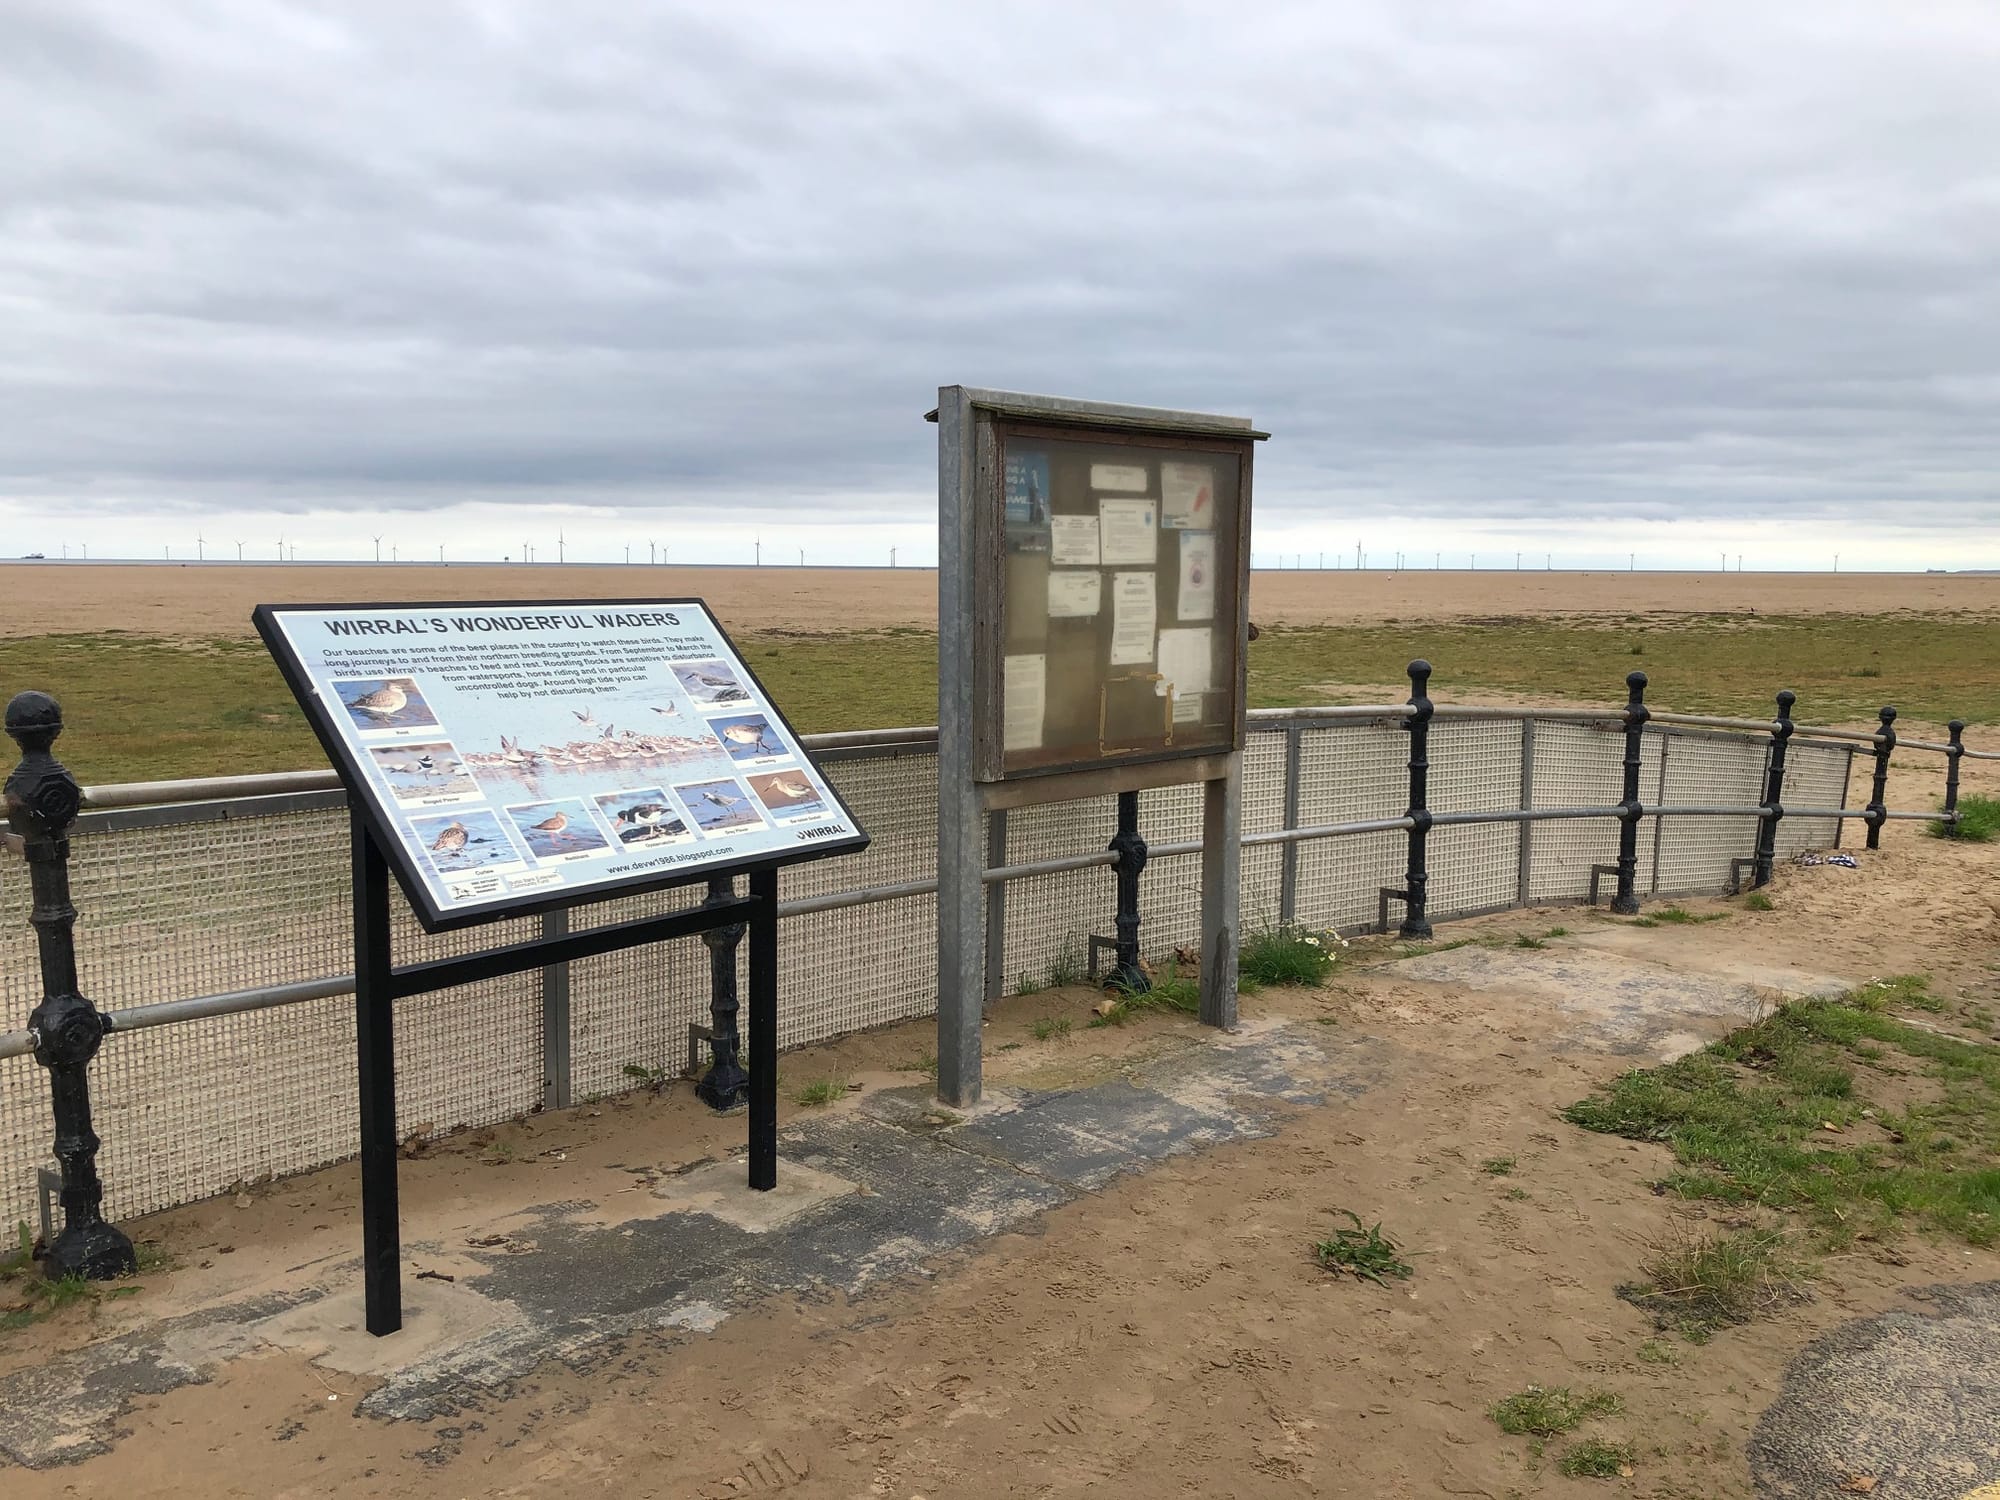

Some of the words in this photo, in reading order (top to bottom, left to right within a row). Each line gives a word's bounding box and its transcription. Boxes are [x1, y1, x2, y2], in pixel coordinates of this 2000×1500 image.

[323, 618, 448, 635] WIRRAL'S
[449, 615, 593, 632] WONDERFUL
[592, 612, 680, 627] WADERS
[322, 648, 342, 657] Our
[344, 646, 389, 656] beaches
[390, 647, 407, 655] are
[408, 646, 436, 654] some
[438, 644, 448, 653] of
[449, 644, 465, 653] the
[465, 643, 488, 652] best
[489, 642, 519, 652] places
[519, 641, 530, 650] in
[530, 641, 546, 649] the
[547, 640, 579, 649] country
[580, 639, 590, 647] to
[591, 638, 616, 647] watch
[616, 638, 640, 646] these
[639, 636, 664, 645] birds.
[663, 635, 683, 644] They
[683, 634, 704, 643] make
[324, 658, 350, 668] long
[350, 657, 396, 667] journeys
[397, 656, 409, 664] to
[410, 654, 430, 664] and
[430, 654, 455, 663] from
[455, 652, 477, 662] their
[479, 651, 519, 661] northern
[519, 650, 561, 659] breeding
[561, 648, 597, 658] grounds.
[599, 647, 622, 655] From
[622, 645, 665, 655] September
[665, 644, 675, 652] to
[674, 643, 700, 651] March
[699, 642, 712, 650] the
[333, 667, 362, 677] birds
[364, 668, 383, 676] use
[384, 665, 424, 675] Wirral's
[425, 663, 467, 673] beaches
[468, 663, 479, 671] to
[479, 661, 501, 671] feed
[502, 660, 520, 670] and
[521, 660, 542, 668] rest.
[542, 658, 583, 667] Roosting
[583, 656, 609, 665] flocks
[625, 654, 661, 663] sensitive
[671, 651, 715, 661] disturbance
[441, 673, 466, 682] from
[466, 671, 525, 681] watersports,
[525, 669, 552, 678] horse
[553, 668, 580, 677] riding
[580, 666, 597, 675] and
[597, 666, 607, 674] in
[607, 663, 646, 673] particular
[454, 680, 514, 691] uncontrolled
[515, 679, 542, 689] dogs.
[543, 677, 576, 686] Around
[575, 675, 596, 685] high
[596, 675, 614, 683] tide
[614, 674, 631, 684] you
[632, 673, 647, 681] can
[496, 690, 518, 700] help
[518, 689, 531, 699] by
[532, 688, 549, 697] not
[550, 685, 595, 695] disturbing
[594, 684, 619, 693] them.
[805, 825, 846, 838] WIRRAL
[606, 846, 733, 873] www.devw1986.blogspot.com
